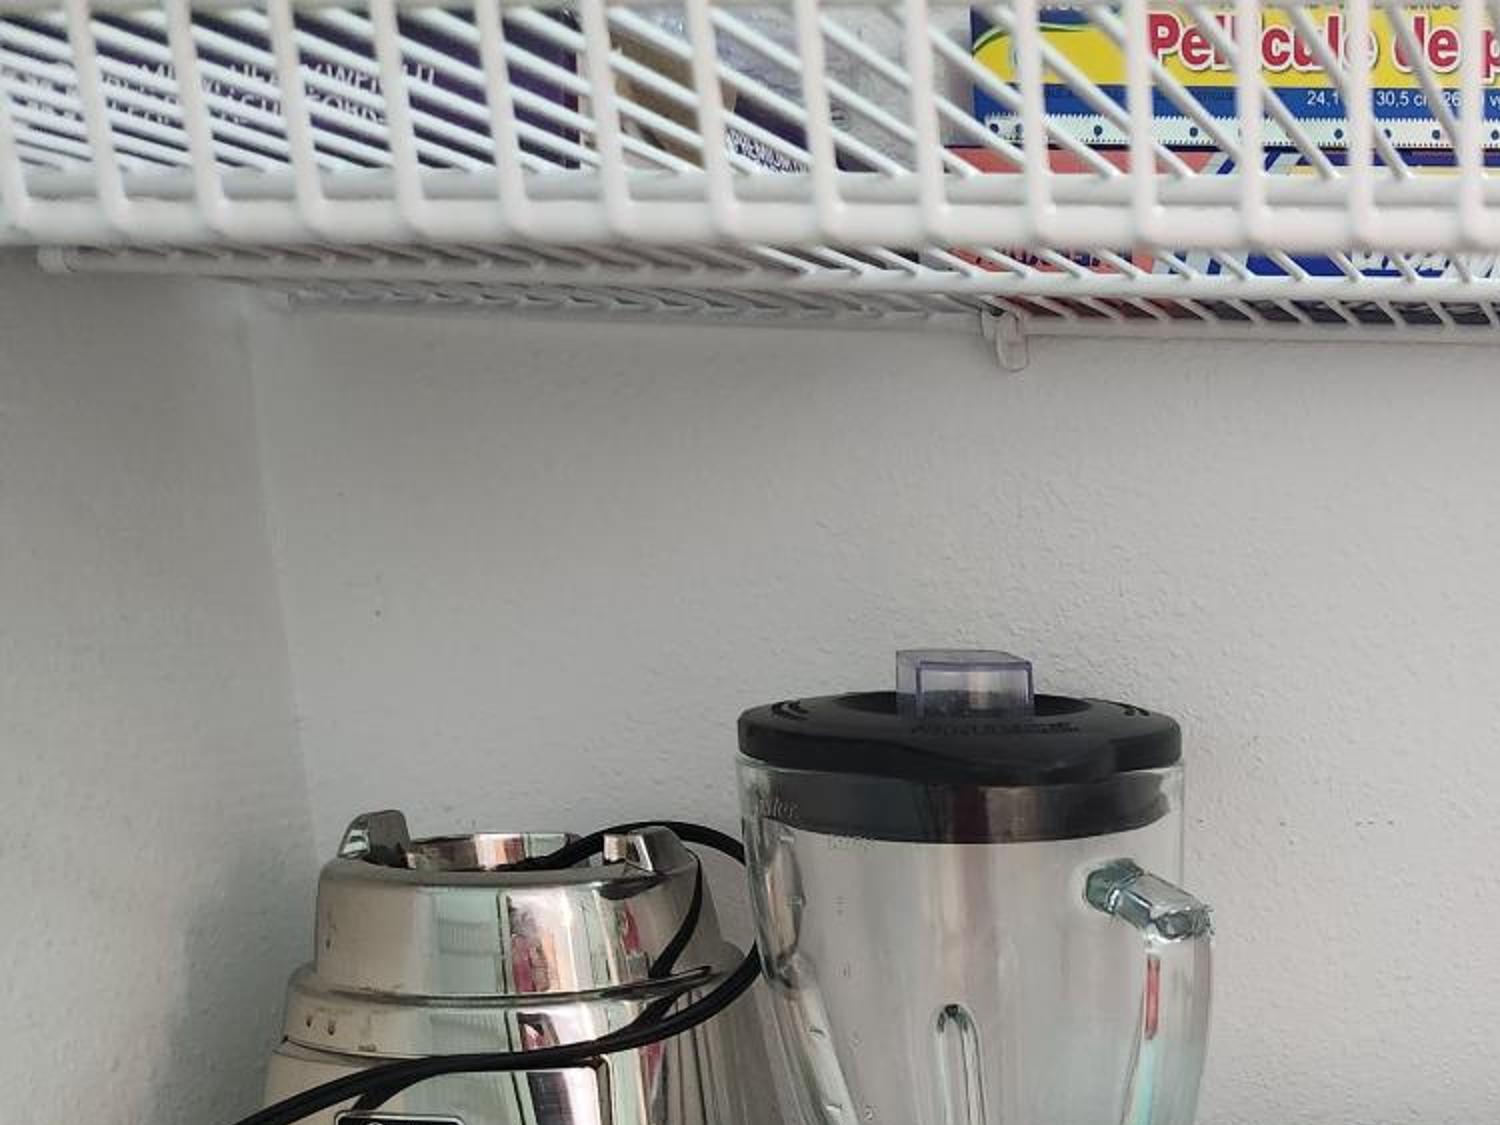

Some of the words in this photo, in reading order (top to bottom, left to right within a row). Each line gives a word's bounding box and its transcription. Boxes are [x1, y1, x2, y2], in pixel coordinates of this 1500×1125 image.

[1145, 13, 1378, 70] Pelcul
[1394, 14, 1461, 70] de
[1376, 90, 1409, 107] 30,5
